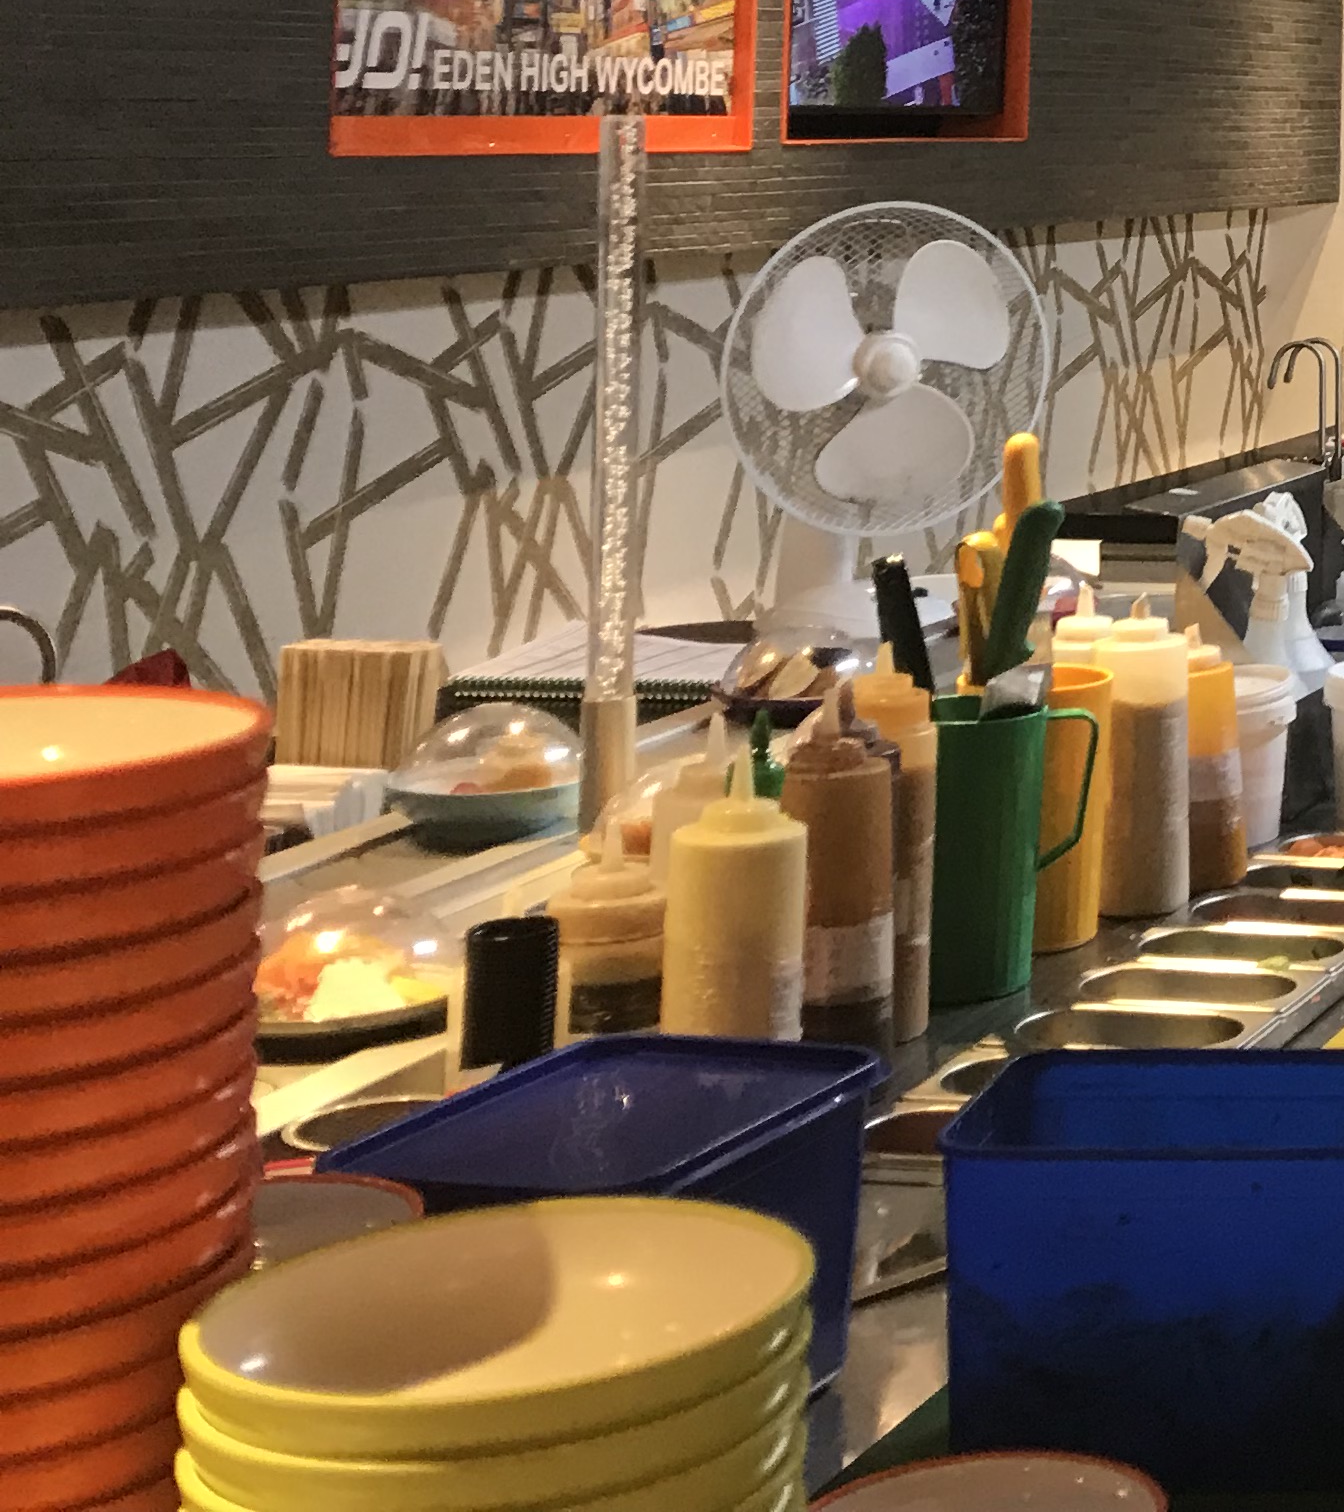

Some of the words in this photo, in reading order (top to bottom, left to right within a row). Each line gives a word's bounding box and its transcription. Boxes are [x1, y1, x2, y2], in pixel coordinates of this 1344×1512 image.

[433, 48, 514, 91] EDEN
[519, 50, 589, 93] HIGH
[595, 53, 727, 96] WYCOMBE
